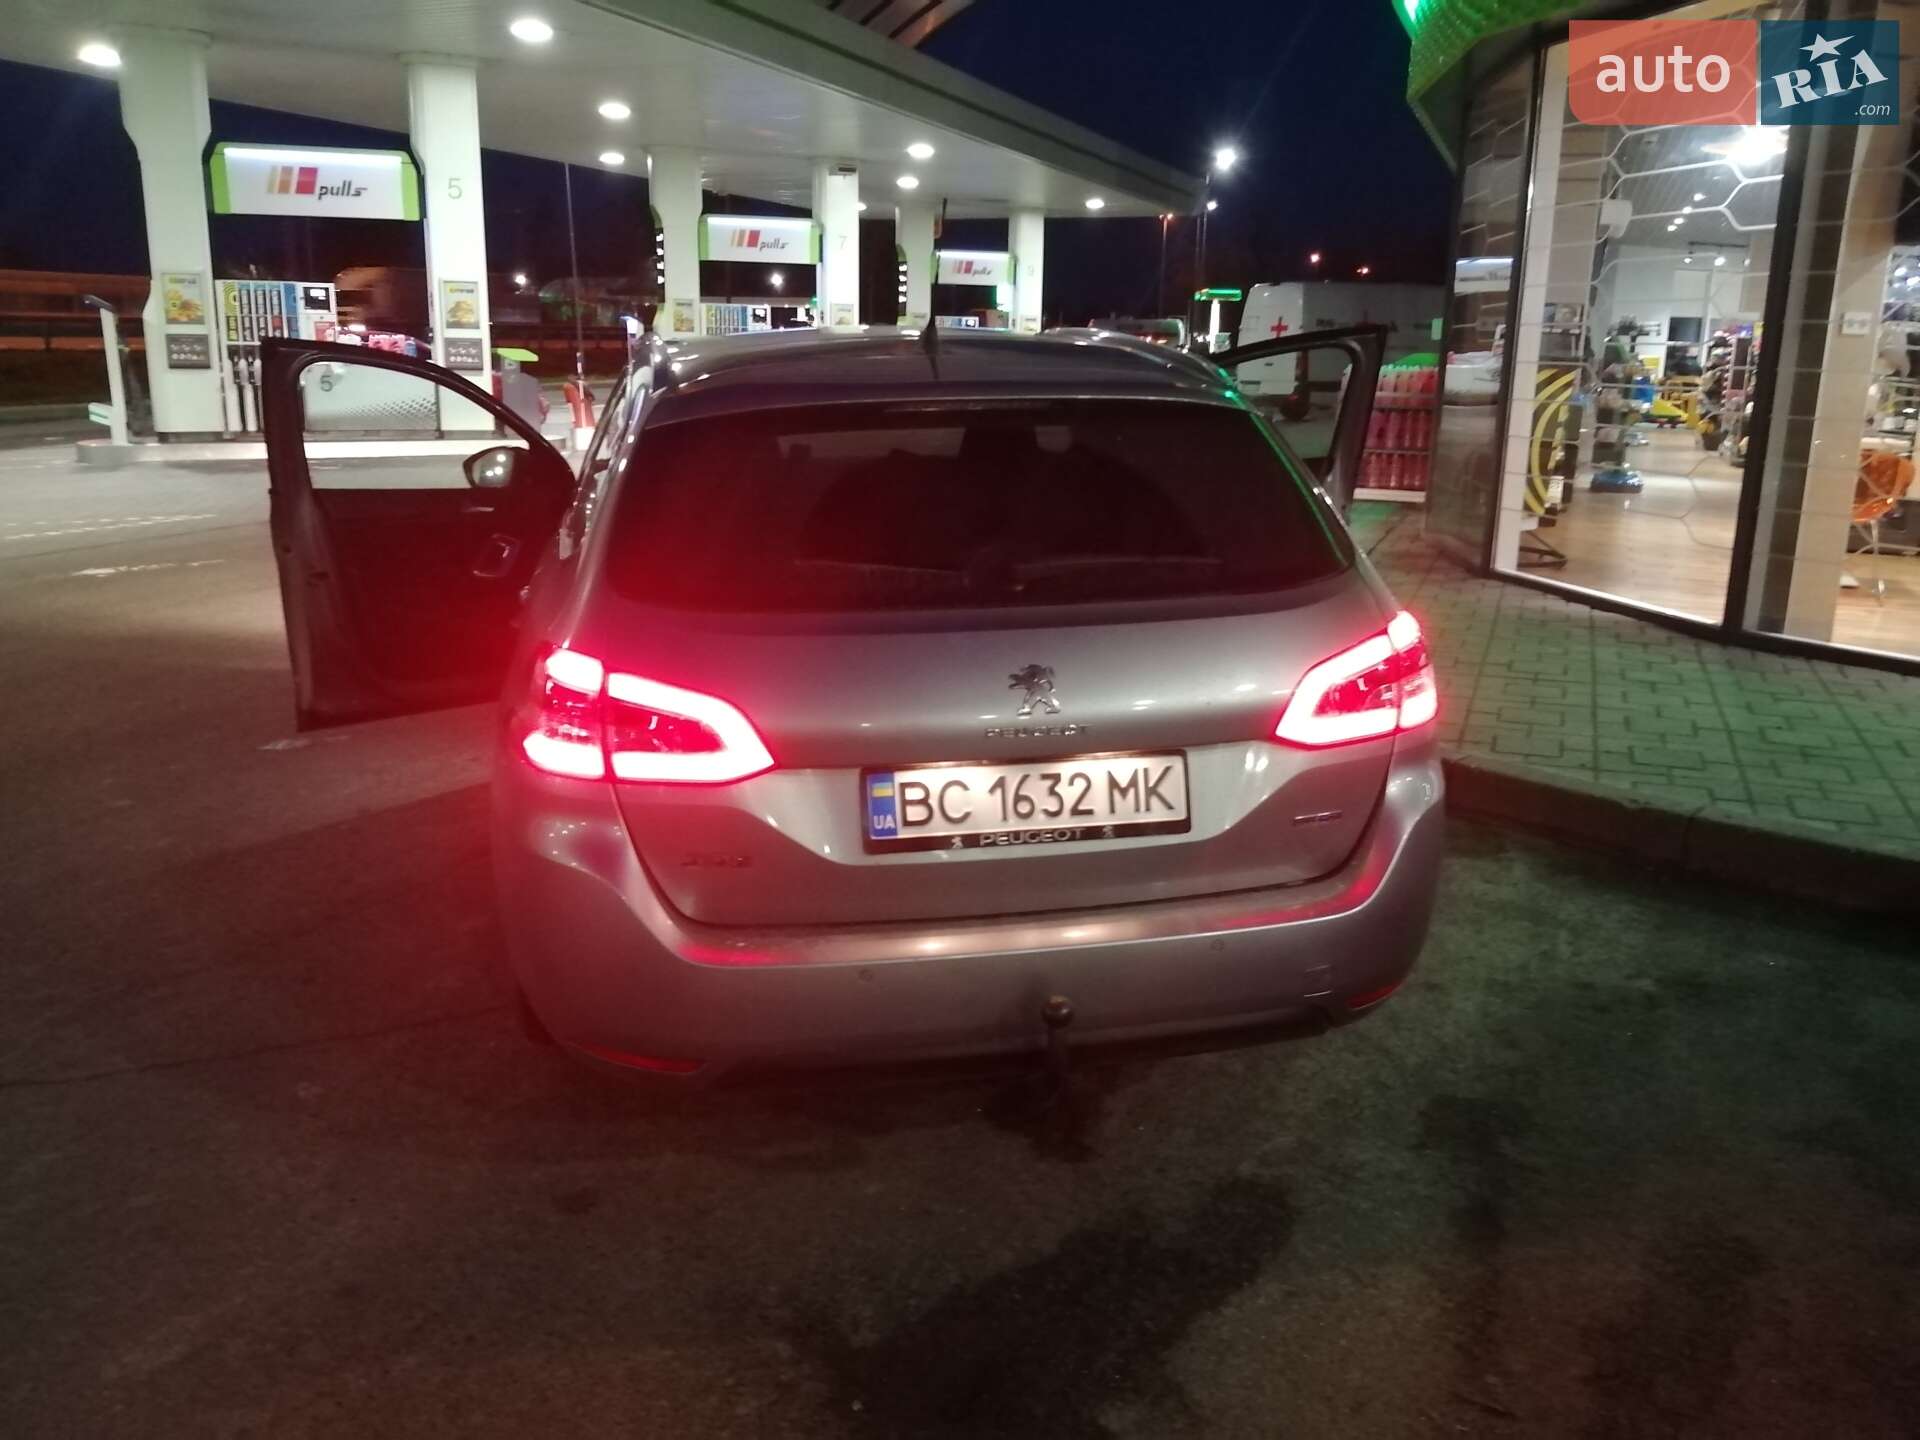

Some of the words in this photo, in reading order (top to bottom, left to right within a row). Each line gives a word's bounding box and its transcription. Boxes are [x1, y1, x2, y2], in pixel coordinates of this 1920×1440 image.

[318, 180, 368, 201] pulls
[447, 177, 463, 200] 5
[320, 375, 334, 392] 5
[984, 723, 1090, 738] PEUGEOT
[899, 779, 972, 828] BC
[988, 772, 1095, 822] 1632
[1107, 764, 1176, 815] MK
[873, 814, 896, 830] UA
[979, 827, 1087, 847] PEUGEOT
